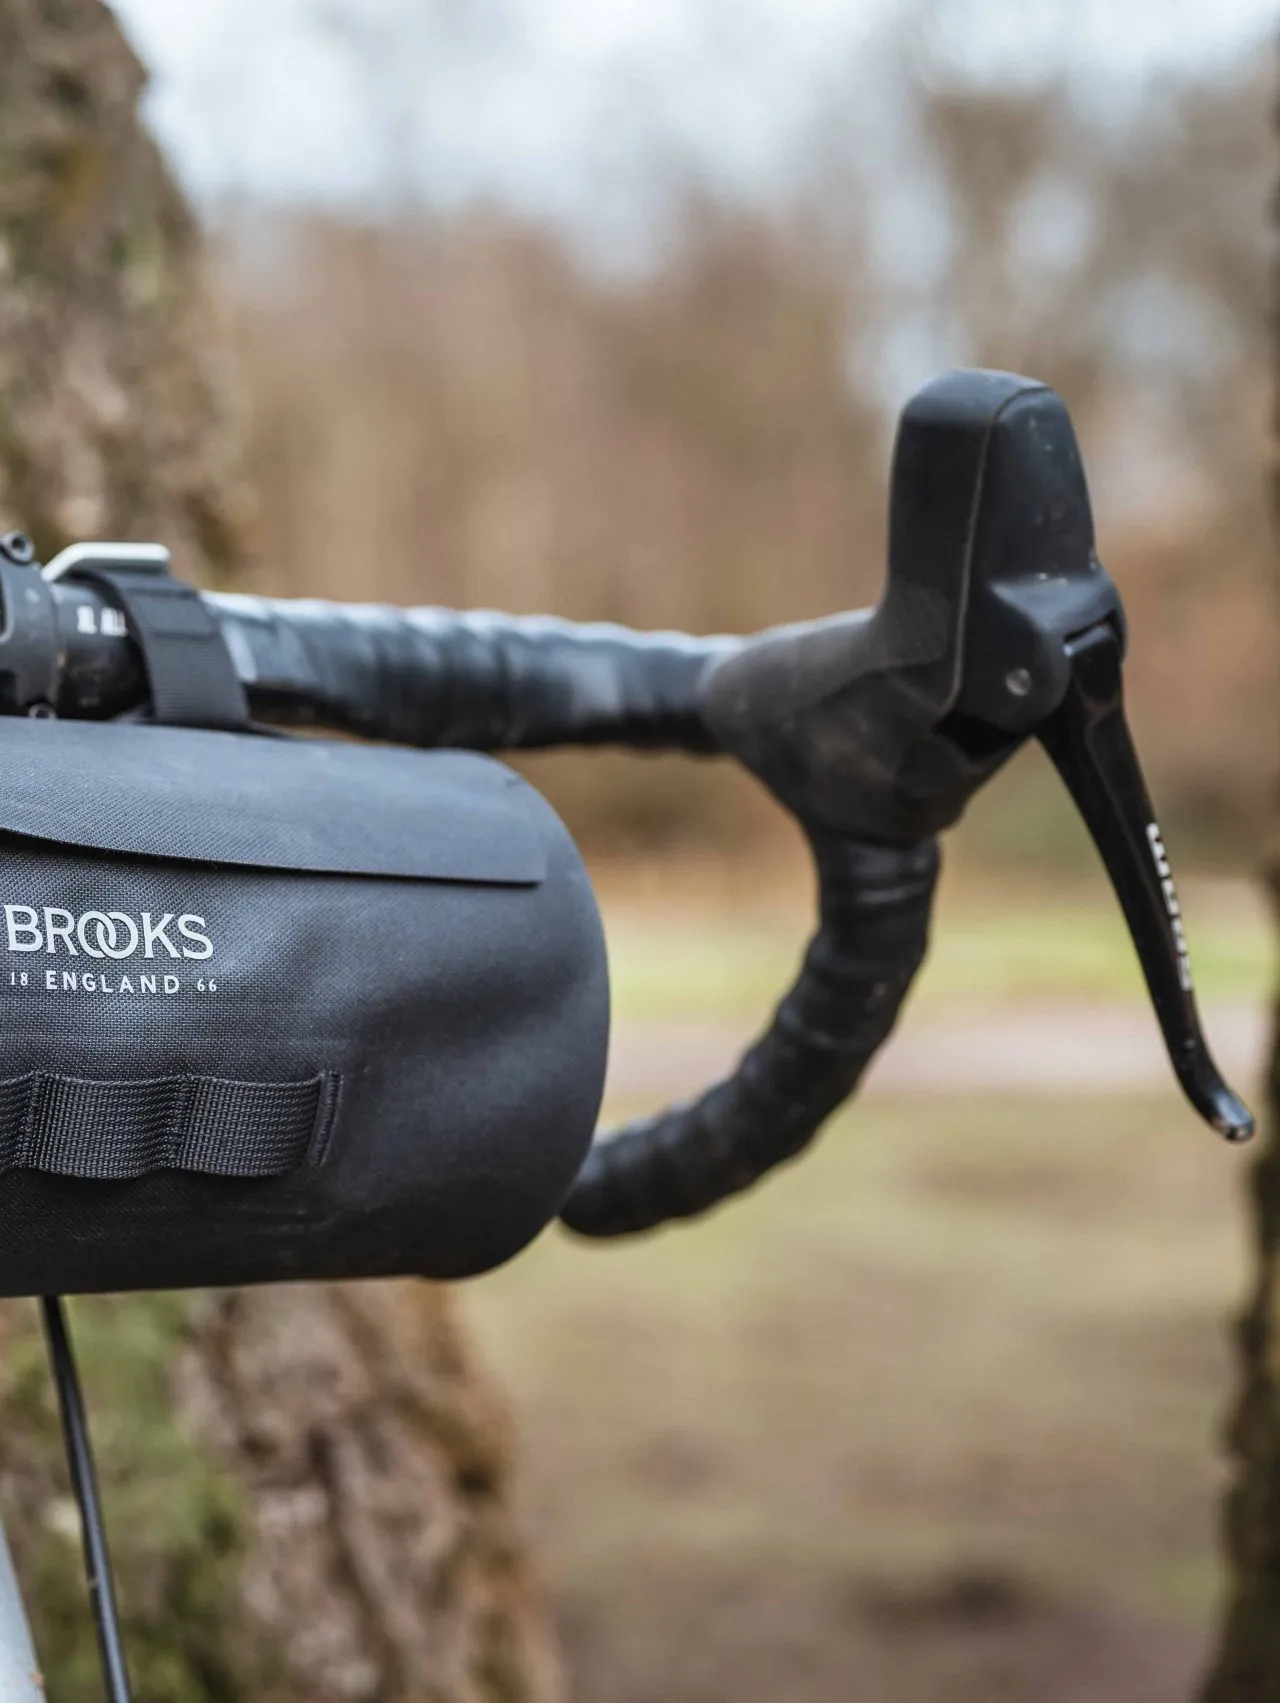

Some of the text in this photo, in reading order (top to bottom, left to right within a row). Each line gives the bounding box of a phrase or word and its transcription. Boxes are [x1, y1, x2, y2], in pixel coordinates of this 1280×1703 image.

[3, 904, 214, 960] BROOKS
[10, 970, 218, 994] 18 ENGLAND 66
